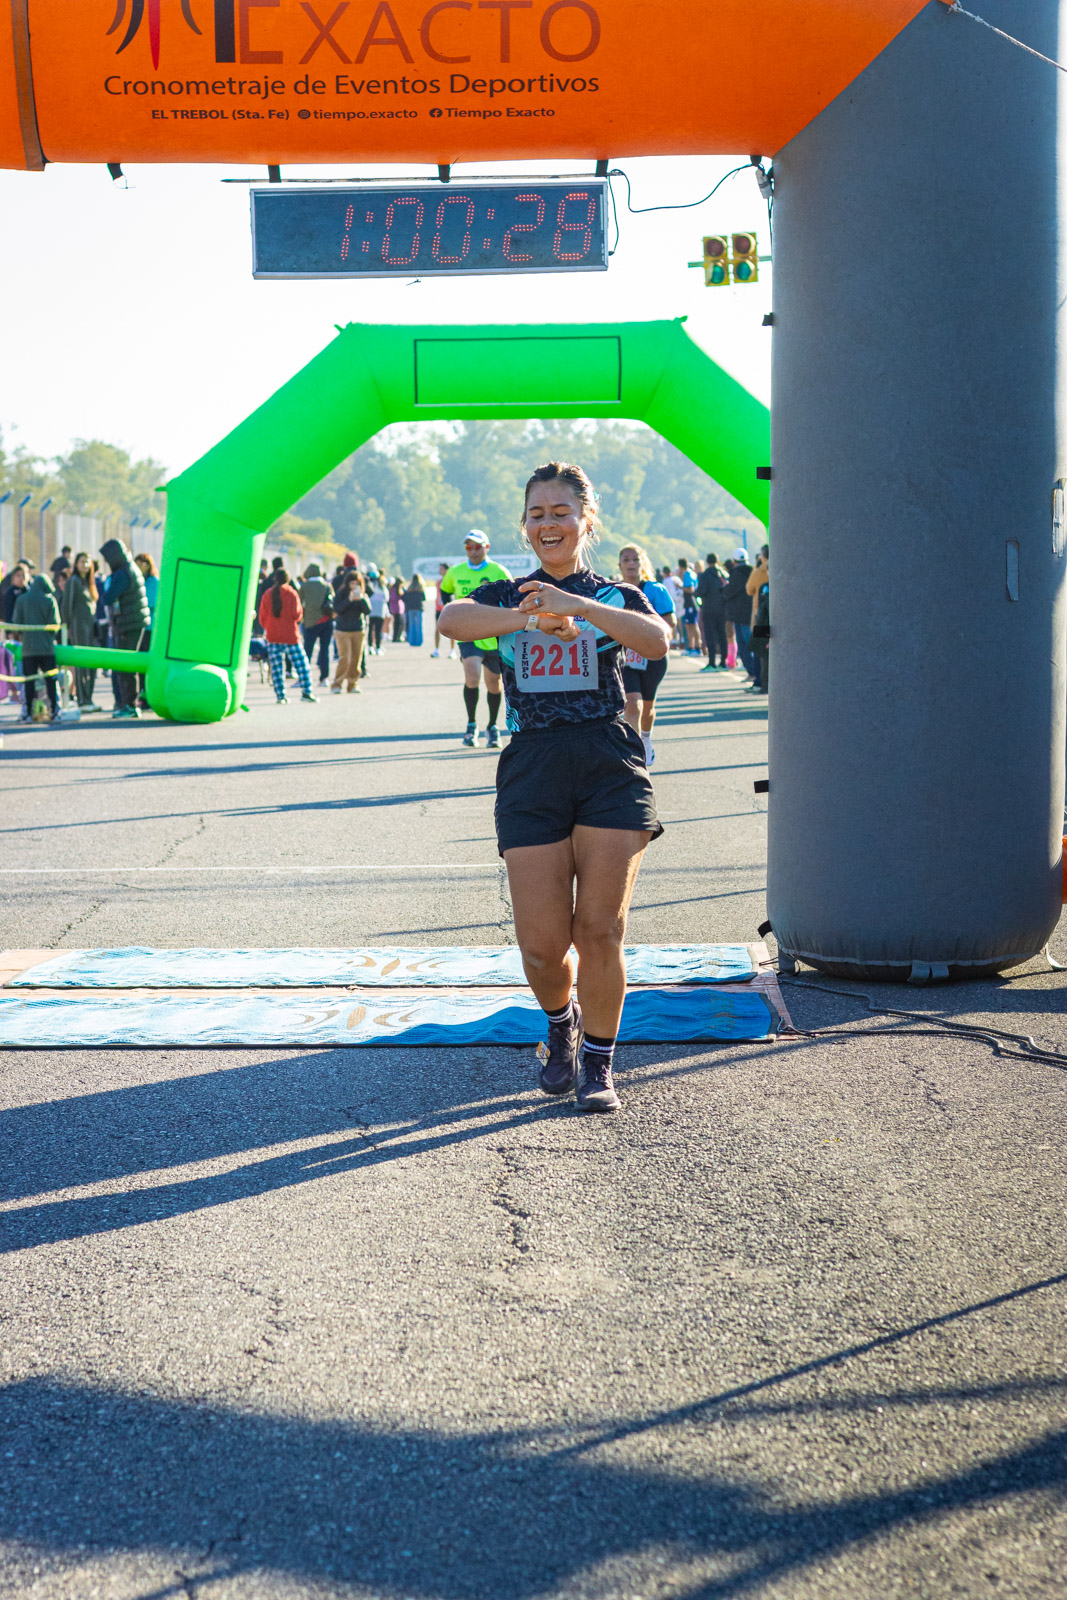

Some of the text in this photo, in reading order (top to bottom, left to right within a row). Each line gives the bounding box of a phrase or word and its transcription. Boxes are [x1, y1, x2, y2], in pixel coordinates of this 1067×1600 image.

[104, 73, 600, 99] Cronometraje de Eventos Deportivos
[151, 107, 556, 121] EL TREBOL (Sta. Fe) tiempo.exacto Tiempo Exacto
[341, 193, 595, 264] 1:00:28
[530, 644, 580, 676] 221
